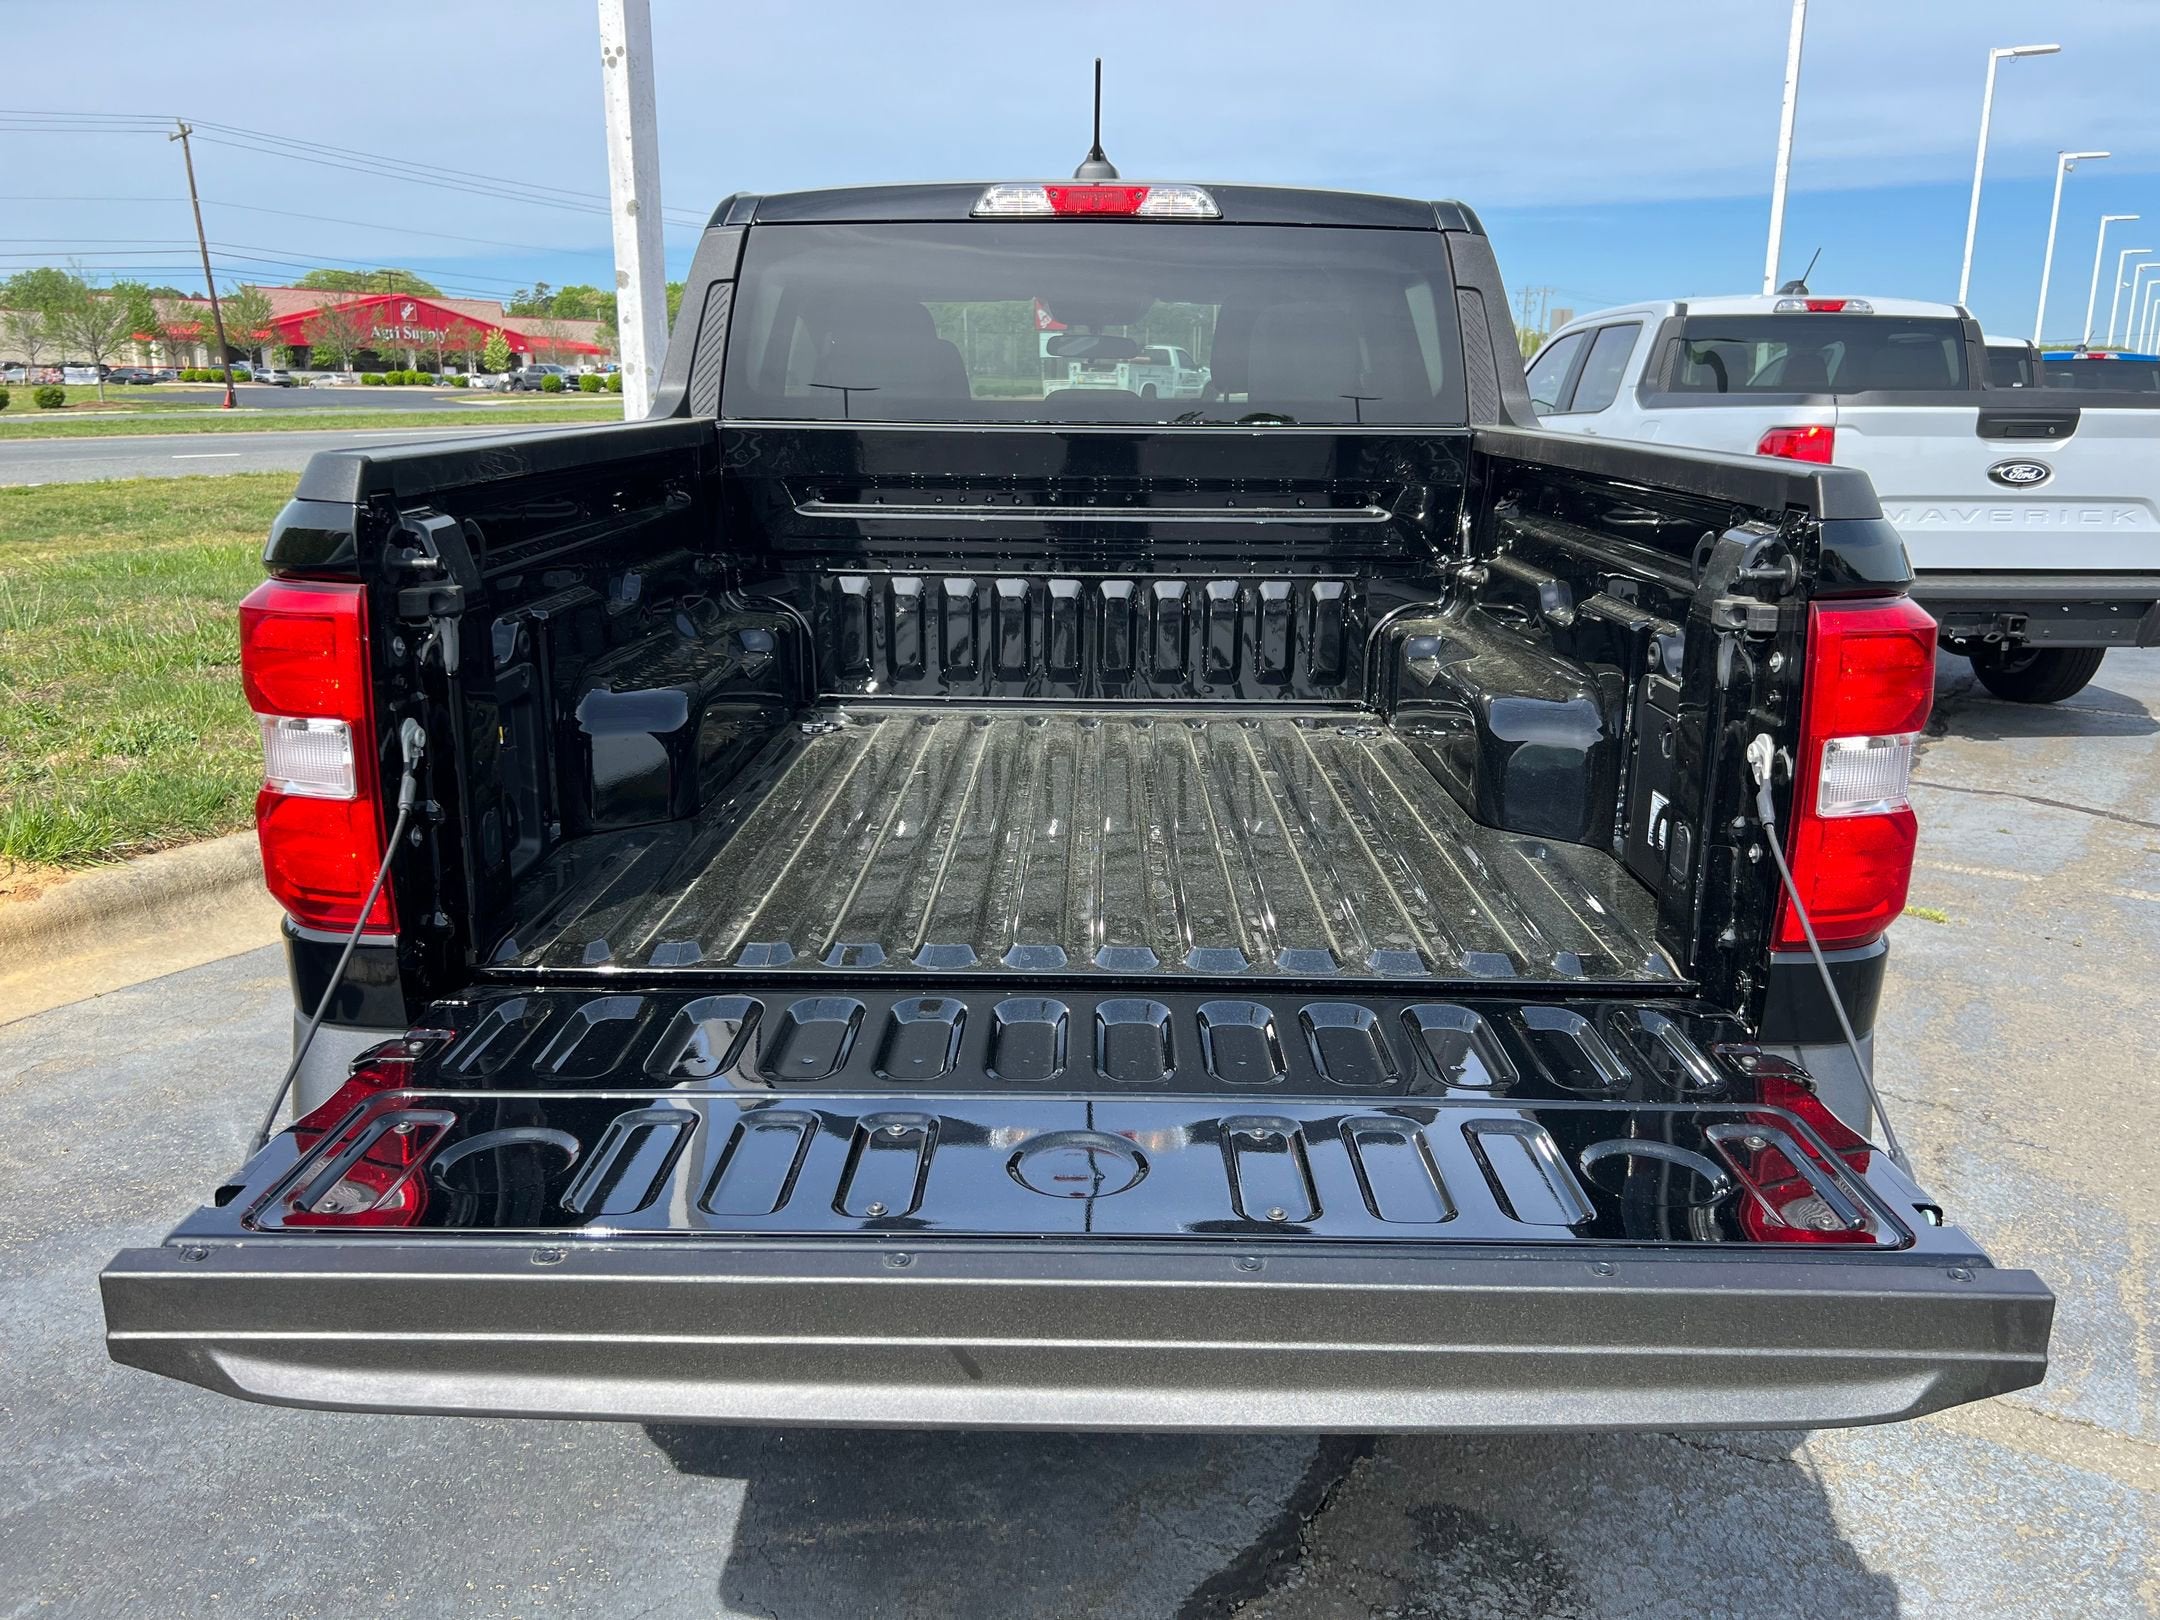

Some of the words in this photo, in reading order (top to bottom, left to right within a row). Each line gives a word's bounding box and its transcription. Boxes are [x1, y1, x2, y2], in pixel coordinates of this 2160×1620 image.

[371, 326, 400, 342] Agri
[403, 326, 449, 344] Supply
[2008, 467, 2038, 479] Ford
[1882, 508, 2137, 525] MAVERICK
